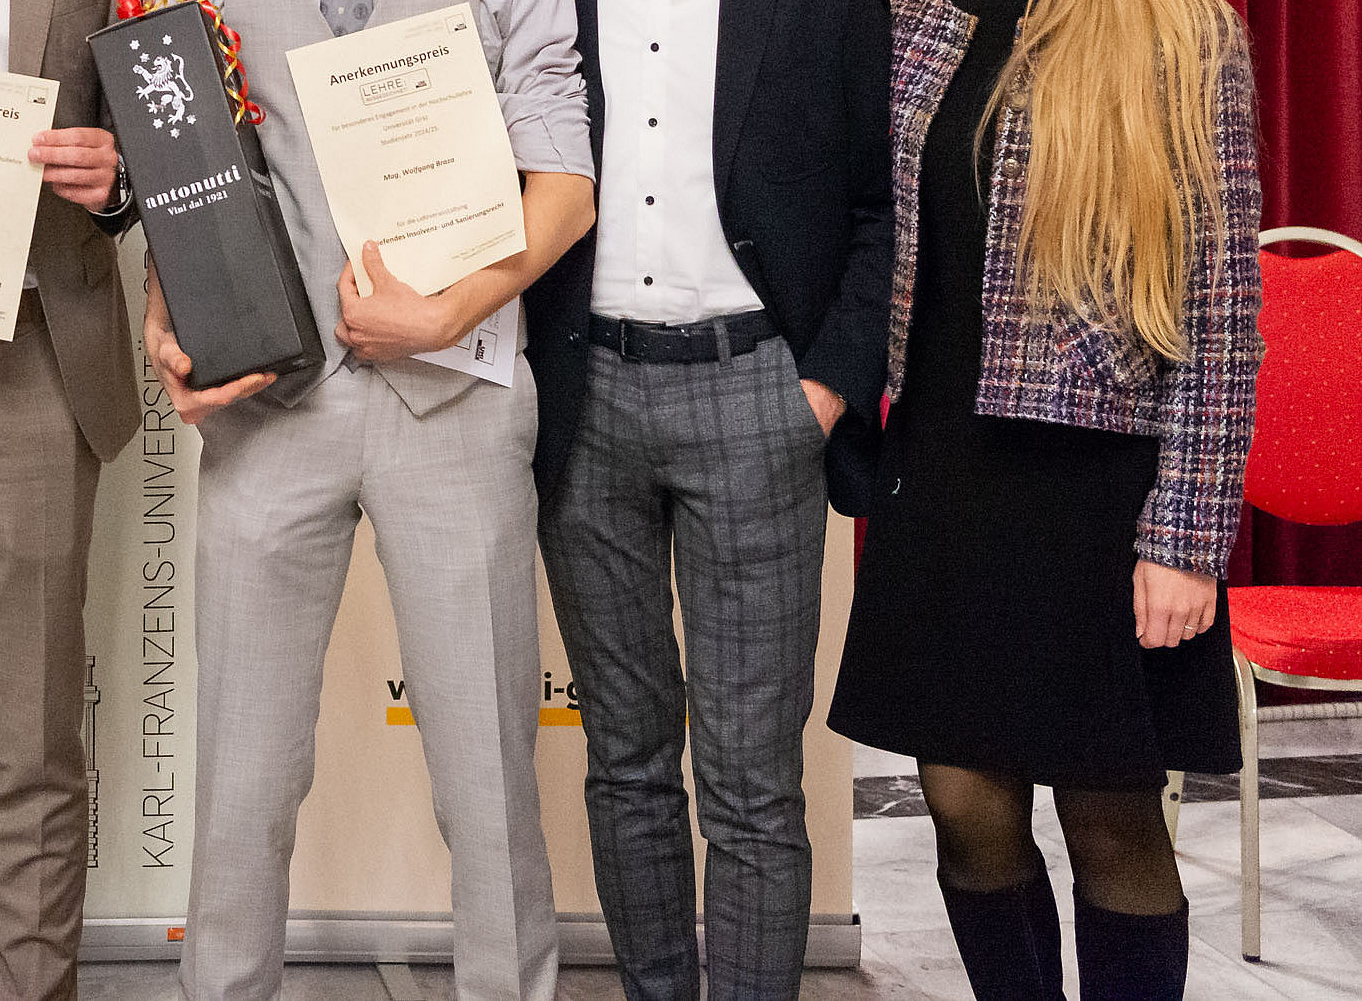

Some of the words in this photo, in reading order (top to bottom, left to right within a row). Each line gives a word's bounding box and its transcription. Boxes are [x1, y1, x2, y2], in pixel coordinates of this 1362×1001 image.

[329, 45, 450, 86] Anerkennungspreis
[362, 78, 402, 97] LEHRE
[145, 164, 241, 209] antonutti
[189, 198, 204, 209] dal
[206, 190, 228, 204] 1921
